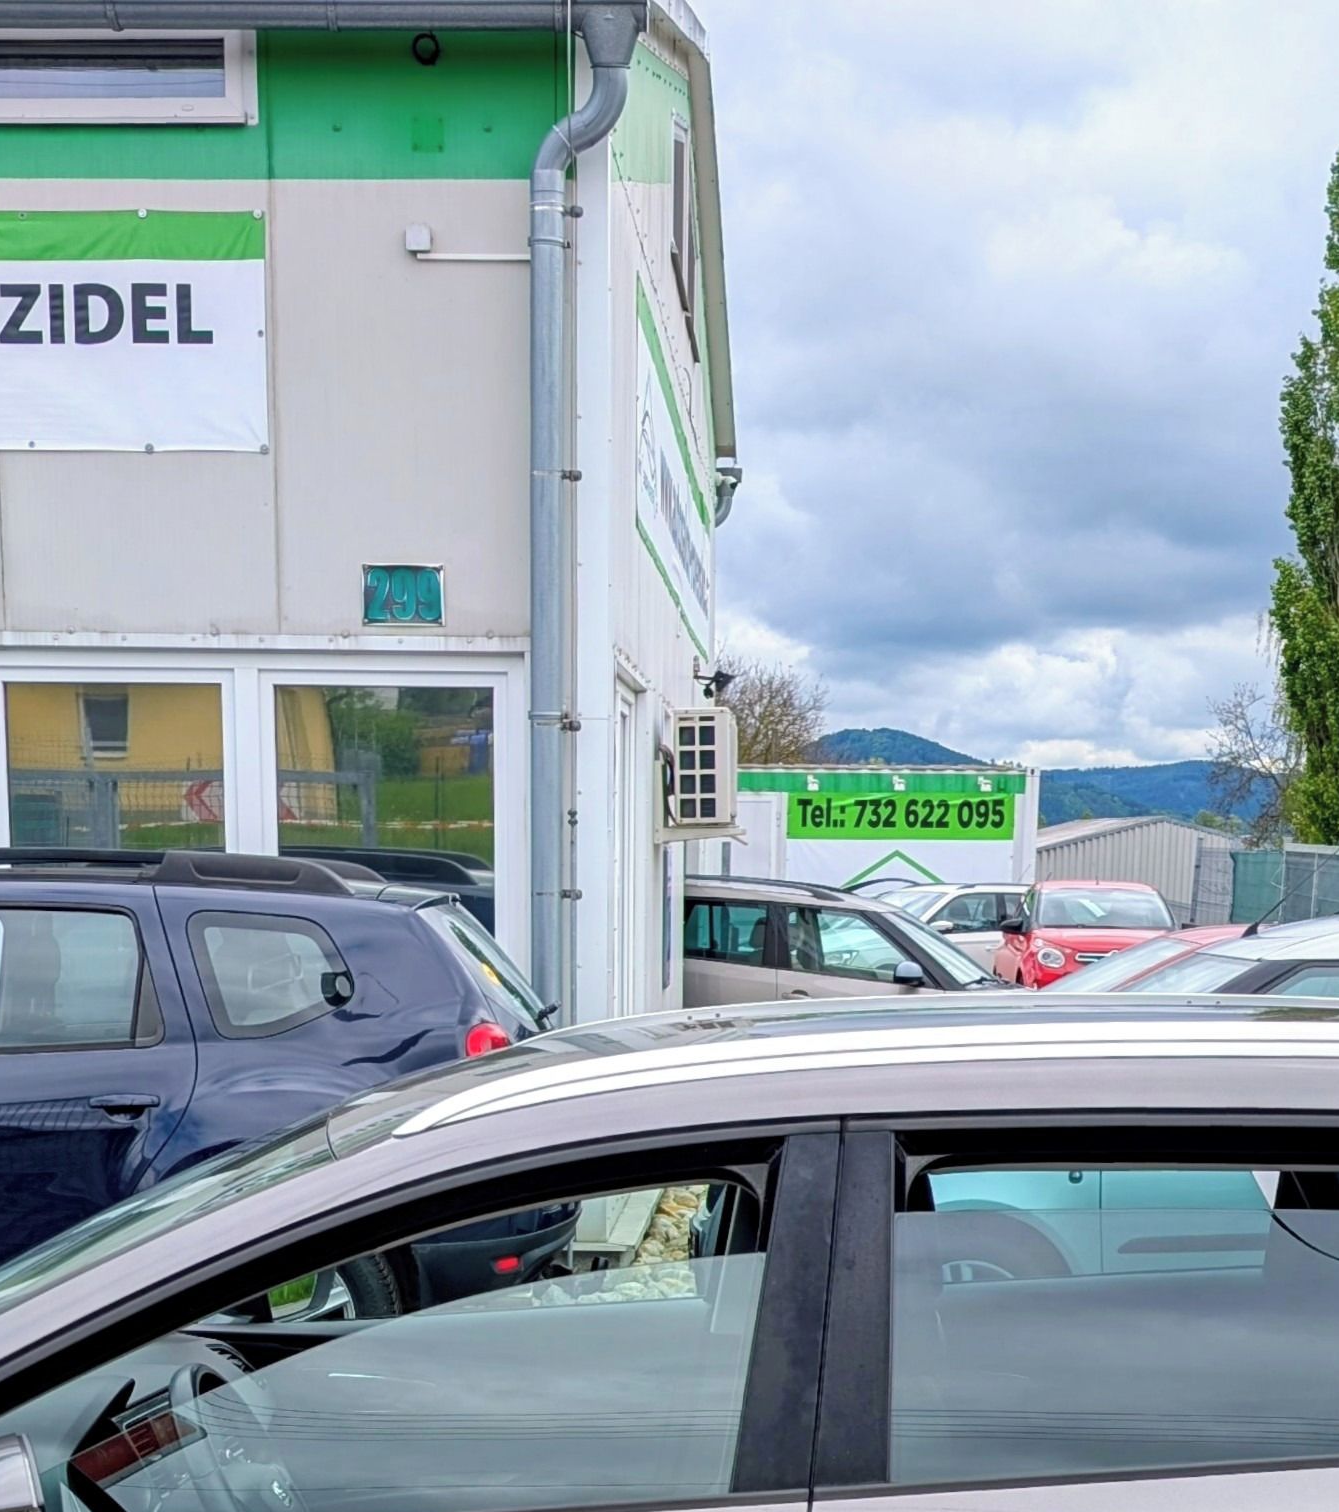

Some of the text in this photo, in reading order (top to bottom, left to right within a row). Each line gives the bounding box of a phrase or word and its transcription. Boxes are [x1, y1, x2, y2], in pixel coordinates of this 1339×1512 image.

[367, 567, 441, 620] 299
[797, 798, 1005, 829] Tel.: 732 622 095
